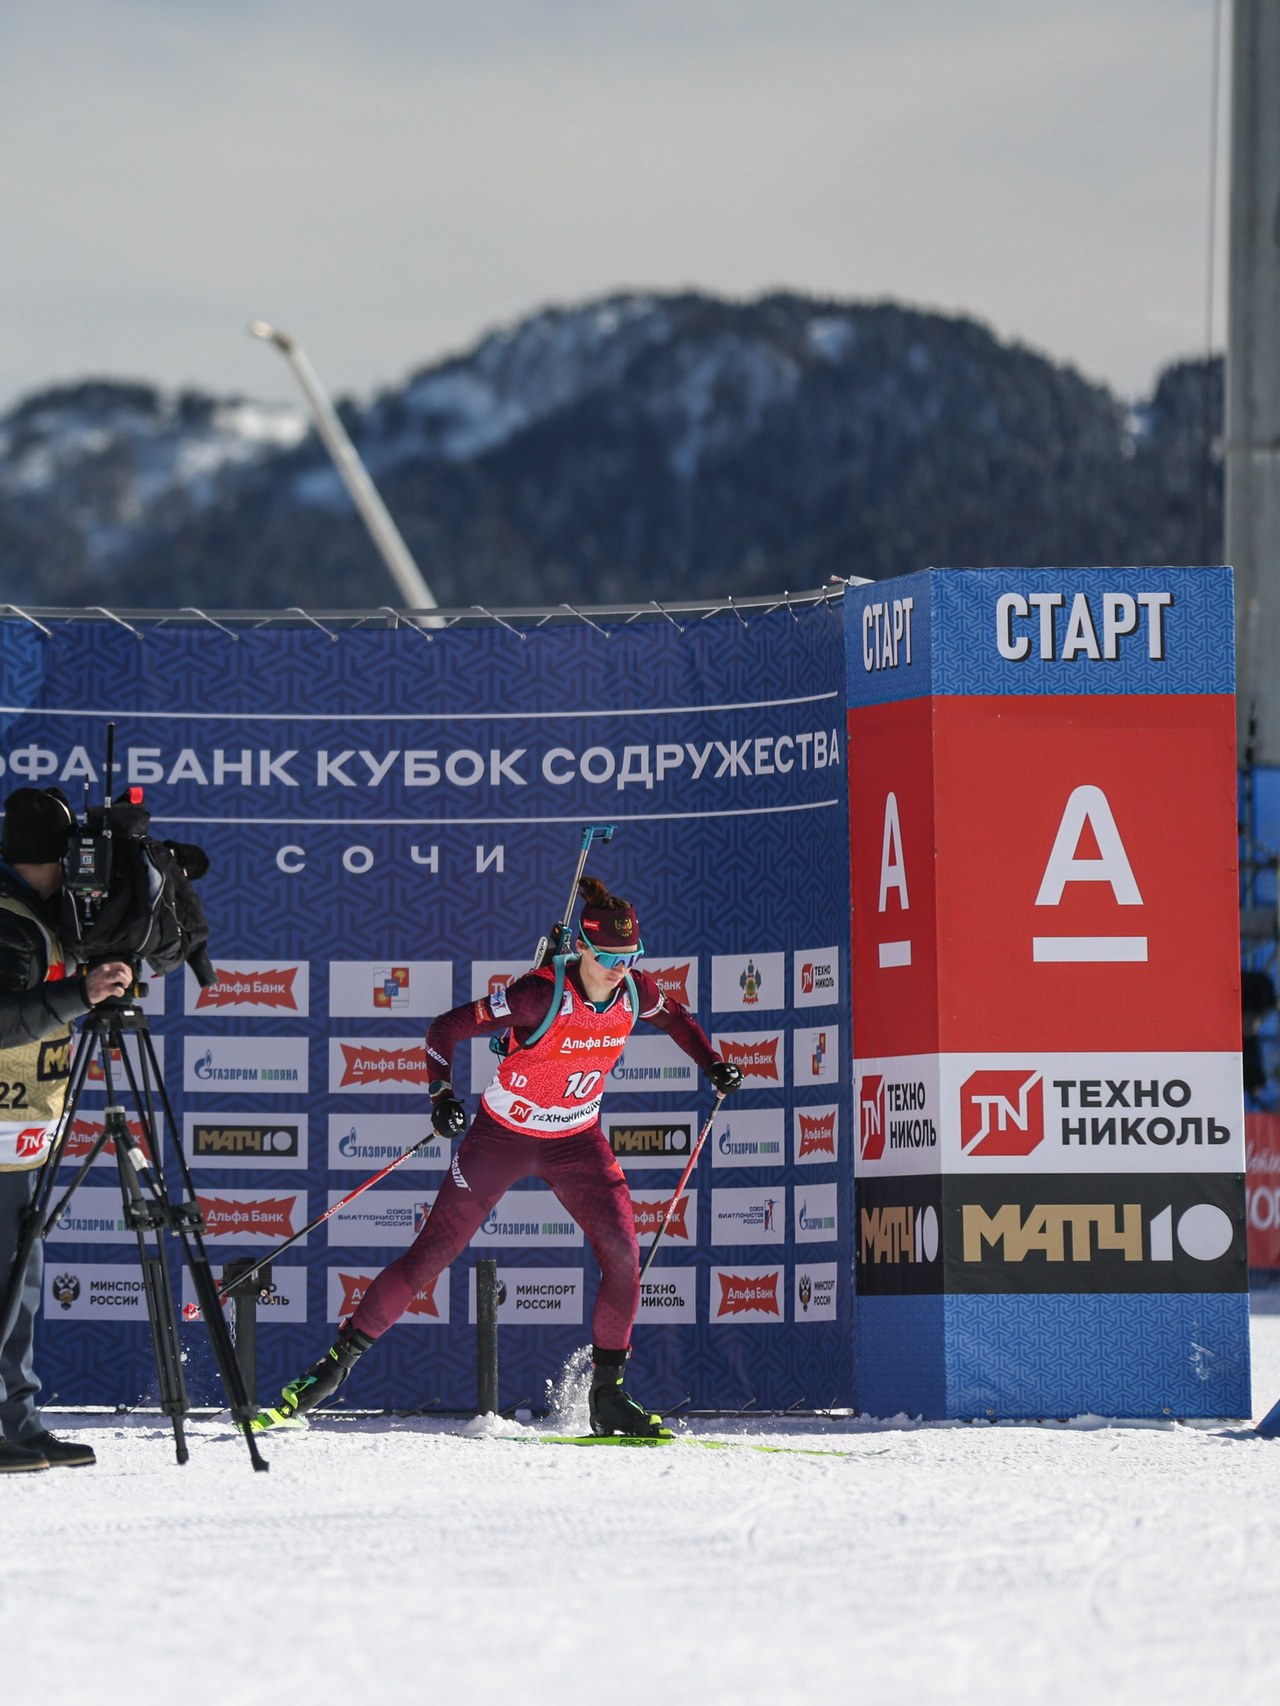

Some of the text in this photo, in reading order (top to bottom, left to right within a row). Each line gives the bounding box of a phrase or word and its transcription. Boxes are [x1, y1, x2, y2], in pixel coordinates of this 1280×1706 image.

[996, 592, 1172, 660] СТАРТ
[862, 597, 914, 672] СТАРТ
[317, 749, 528, 787] КУБОК
[542, 728, 840, 790] СОДРУЖЕСТВА
[815, 965, 831, 976] ТЕХНО
[209, 982, 285, 997] Альфа Банк
[657, 979, 682, 991] Банк
[562, 1036, 627, 1054] Альфа Банк
[353, 1058, 427, 1074] Альфа Банк
[728, 1052, 773, 1067] Альфа Банк
[212, 1069, 299, 1081] ГАЗПРОМ ПОЛЯНА
[509, 1071, 529, 1089] 10
[624, 1066, 691, 1080] ГАЗПРОМ ПОЛЯНА
[563, 1070, 602, 1099] 10
[888, 1082, 926, 1111] ТЕХНО
[1053, 1079, 1192, 1108] ТЕХНО
[532, 1100, 602, 1123] ТЕХНОНИКОЛЬ
[804, 1127, 832, 1144] Альфа Банк
[890, 1119, 937, 1149] НИКОЛЬ
[1061, 1117, 1231, 1146] НИКОЛЬ
[68, 1131, 109, 1147] Альф
[358, 1146, 402, 1158] ГАЗПРОМ
[731, 1142, 780, 1155] ГАЗПРОМ ПОЛЯНА
[206, 1210, 284, 1226] Альфа Банк
[657, 1211, 681, 1223] Бнк
[72, 1219, 114, 1232] ГАЗПРОМ
[498, 1223, 575, 1235] ГАЗПРОМ ПОЛЯНА
[91, 1281, 150, 1292] МИНСПОР
[516, 1285, 575, 1295] МИНСПОРТ
[640, 1285, 676, 1294] ТЕХНО
[814, 1280, 835, 1291] МИНСПОРТ
[90, 1296, 138, 1306] РОССИИ
[641, 1297, 685, 1307] НИКОЛЬ
[727, 1288, 774, 1304] Альфа Банк
[814, 1295, 831, 1306] РОССИИ
[516, 1299, 561, 1310] РОССИИ
[620, 1438, 658, 1446] FISCHER
